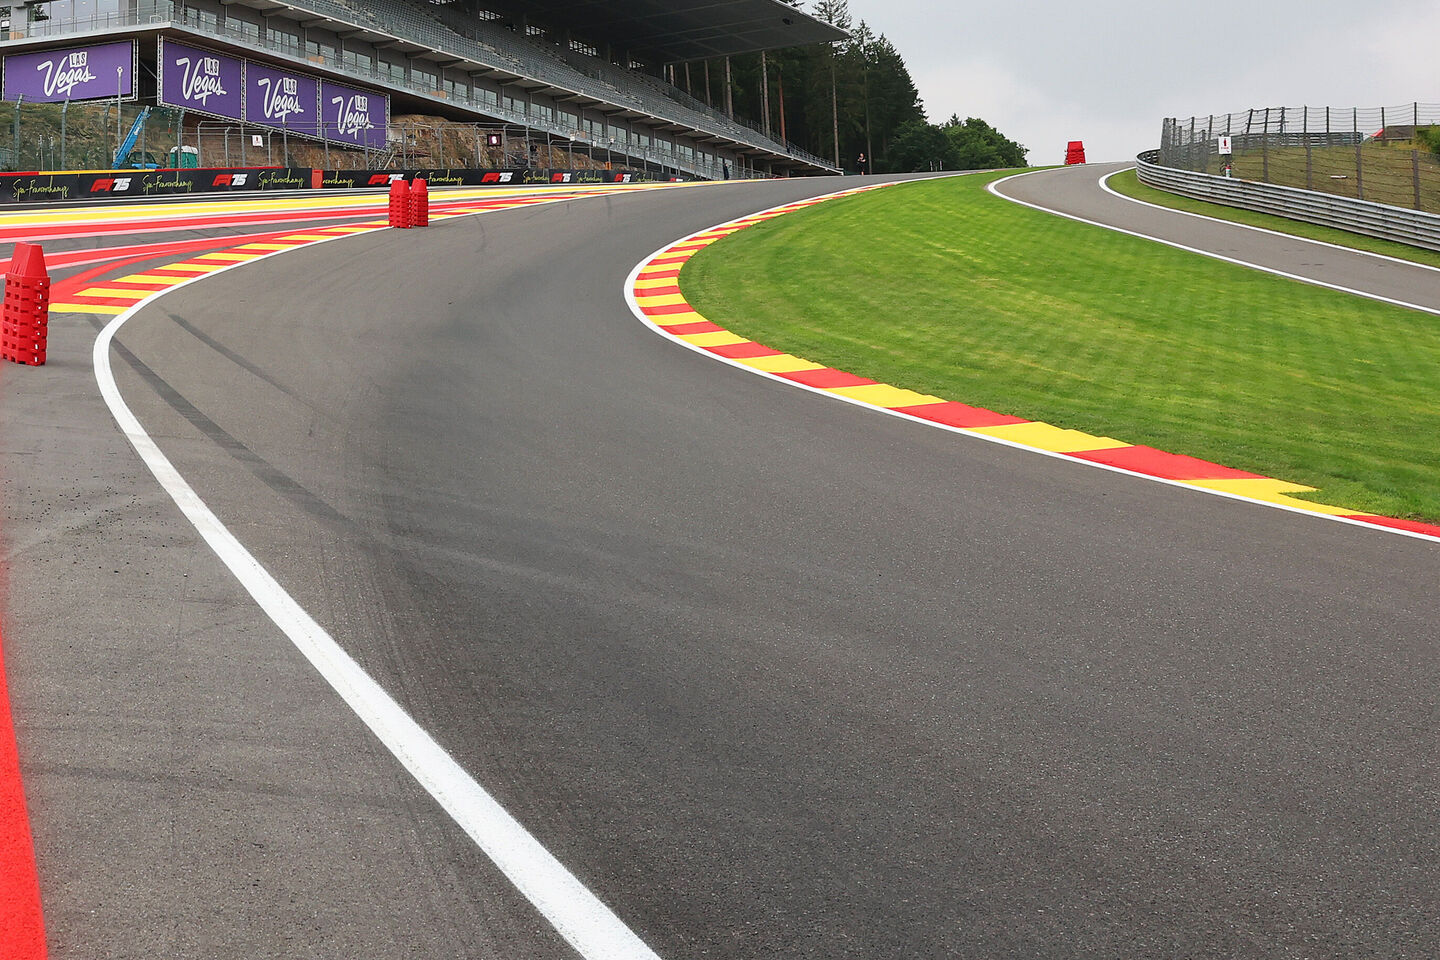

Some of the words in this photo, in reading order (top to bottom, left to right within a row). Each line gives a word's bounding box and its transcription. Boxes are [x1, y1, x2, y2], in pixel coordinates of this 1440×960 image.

[37, 56, 97, 97] Vegas
[70, 53, 86, 65] LAS
[205, 59, 219, 75] LAS
[176, 58, 227, 106] Vegas
[258, 78, 304, 122] Vegas
[332, 96, 374, 139] Vegas
